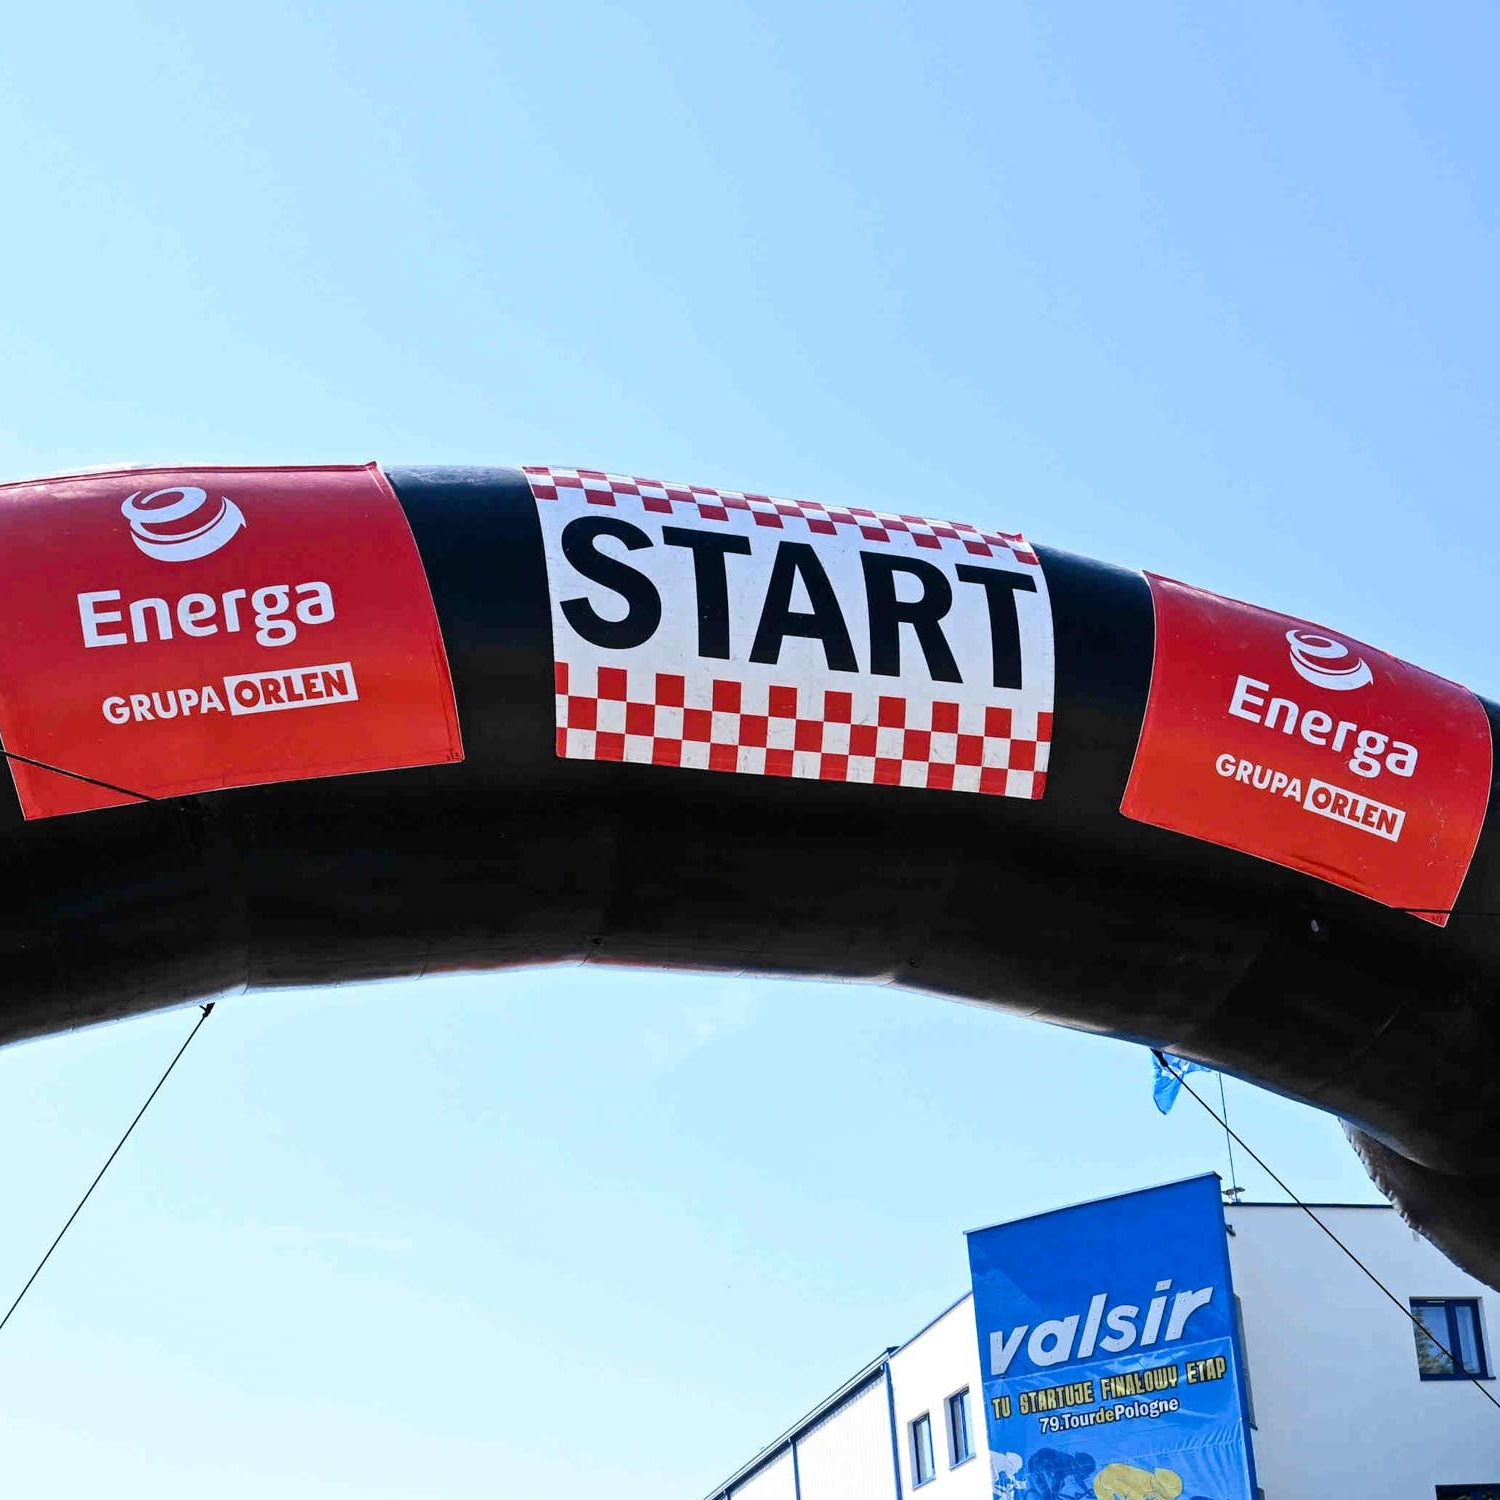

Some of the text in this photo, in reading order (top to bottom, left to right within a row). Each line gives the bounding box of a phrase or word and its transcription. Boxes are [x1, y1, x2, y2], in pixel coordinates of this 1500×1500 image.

[77, 581, 336, 648] Energa
[559, 515, 1039, 690] START
[102, 668, 349, 725] GRUPA ORLEN
[1228, 674, 1418, 779] Energa
[1215, 752, 1401, 836] GRUPA ORLEN
[990, 1279, 1213, 1376] valsir
[992, 1357, 1227, 1420] TU STARTUJE FINAŁOWY ETAP
